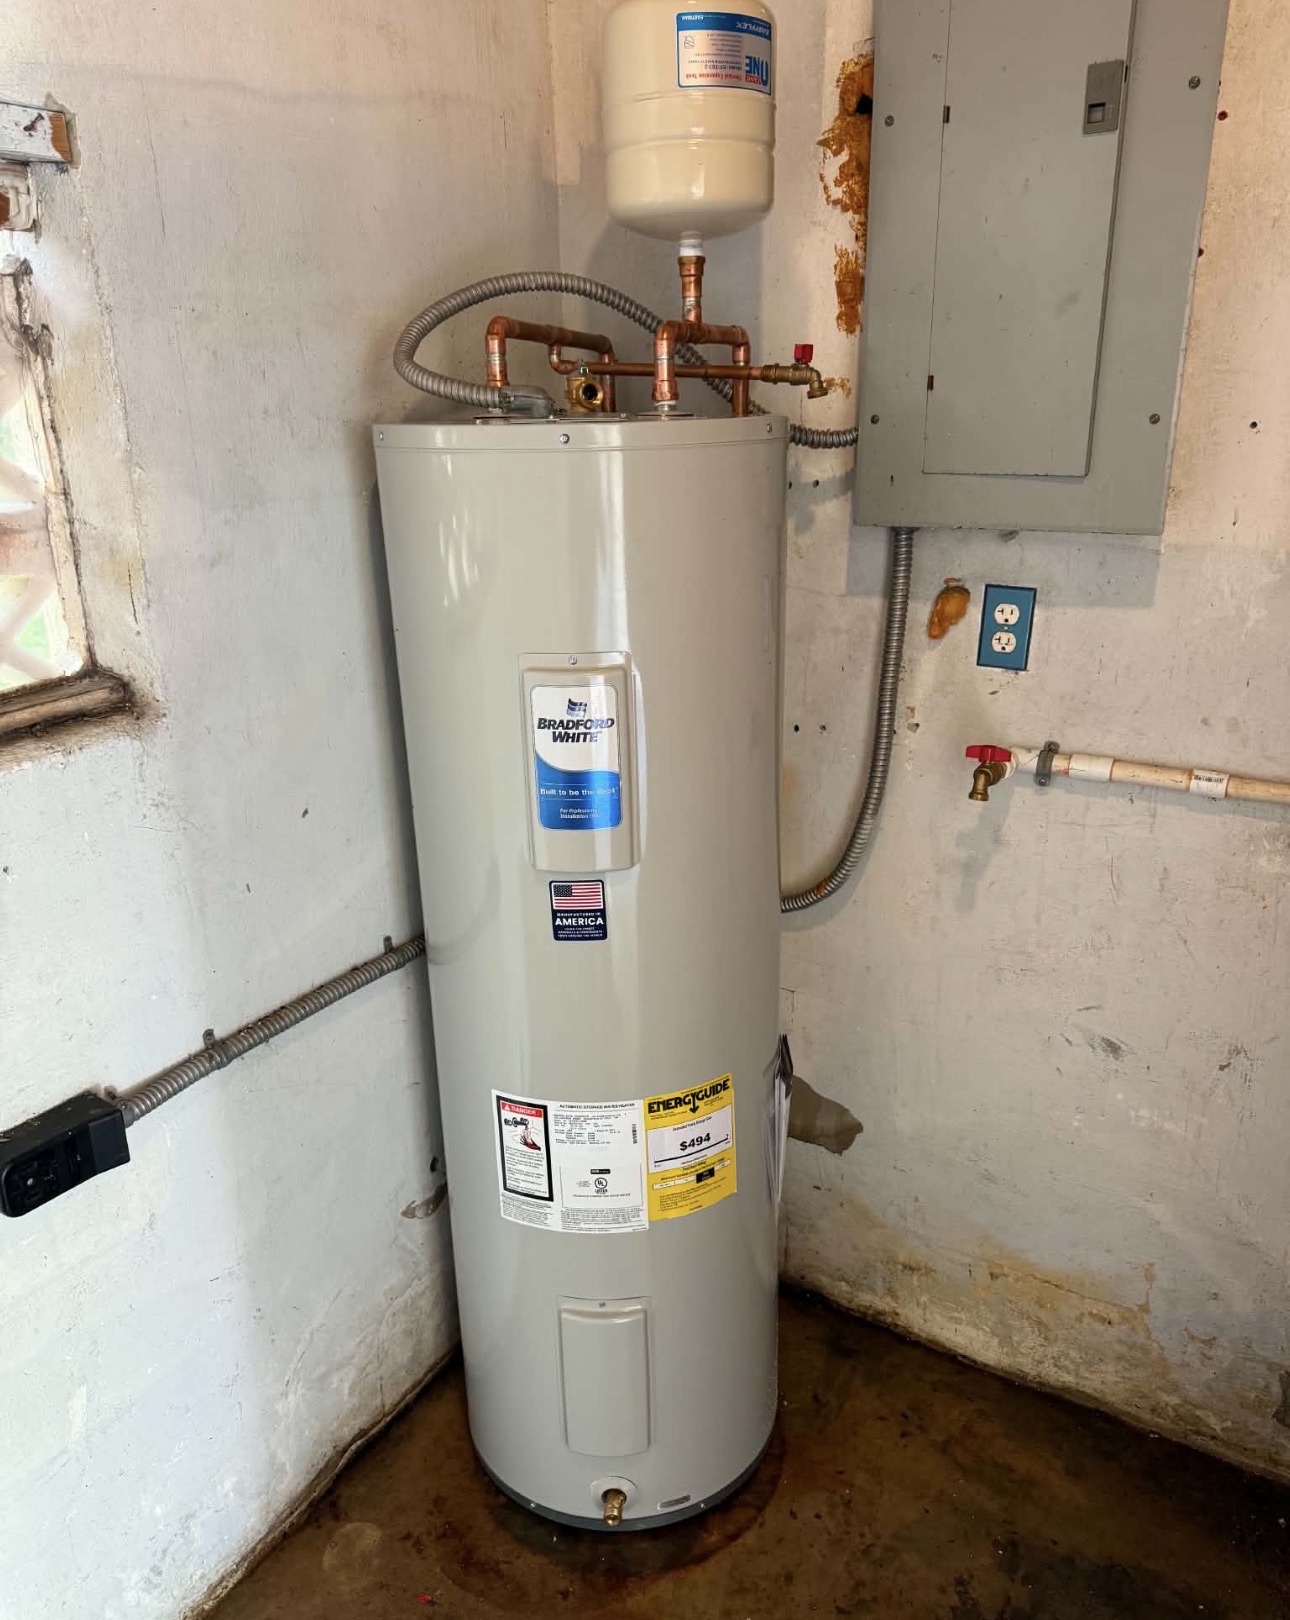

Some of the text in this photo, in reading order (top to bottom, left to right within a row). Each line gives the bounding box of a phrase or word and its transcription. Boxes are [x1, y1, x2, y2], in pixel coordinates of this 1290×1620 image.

[537, 718, 615, 730] BRADFORD
[552, 731, 599, 743] WHITE
[555, 917, 604, 926] AMERICA
[648, 1078, 730, 1114] ENERGYGUIDE
[511, 1105, 537, 1115] DANGER
[680, 1132, 711, 1152] $494
